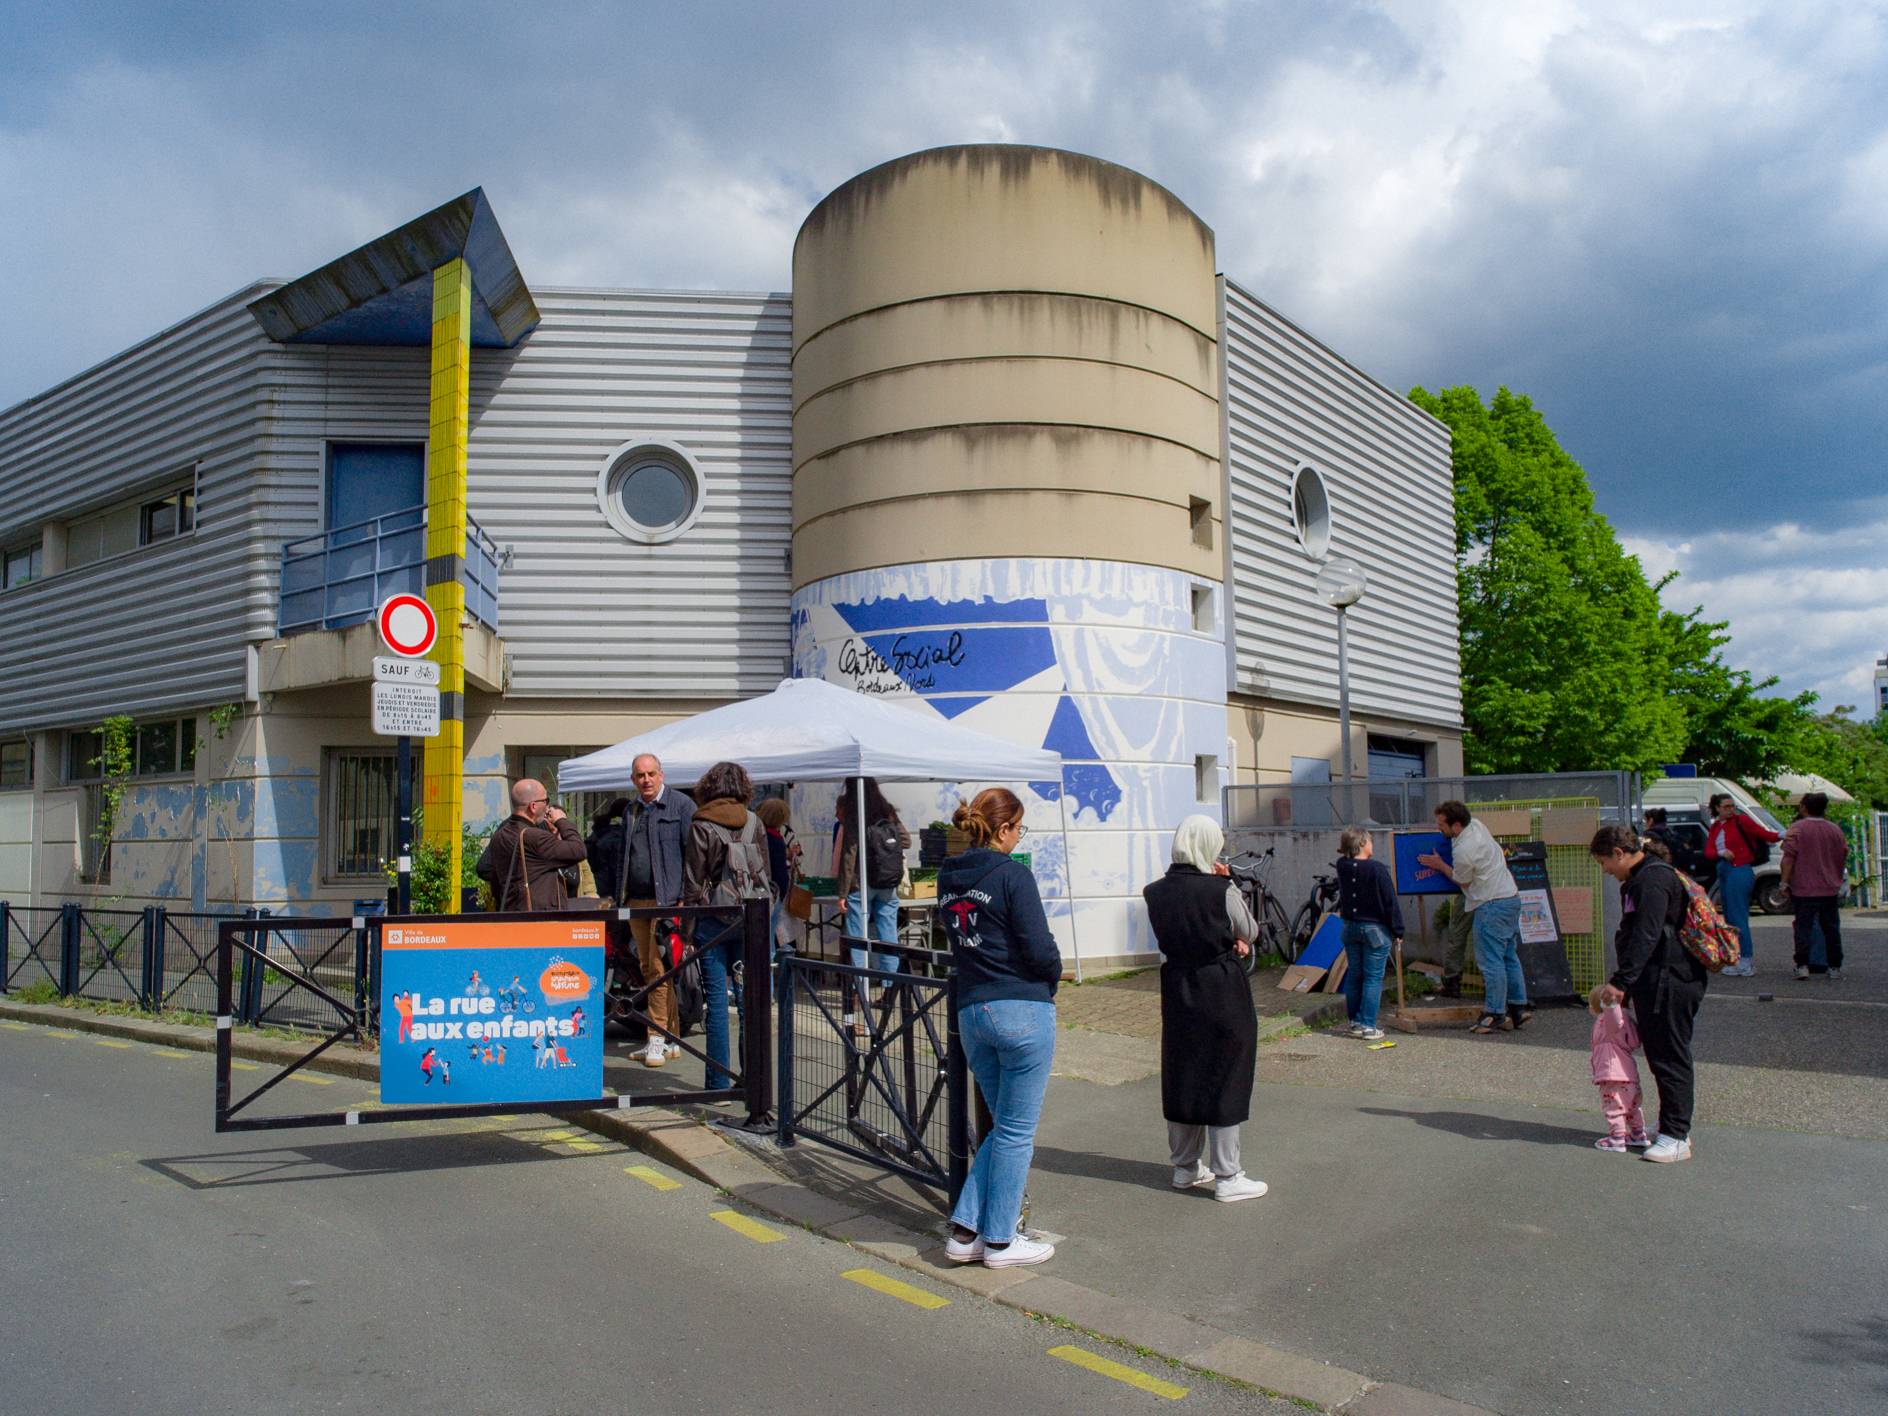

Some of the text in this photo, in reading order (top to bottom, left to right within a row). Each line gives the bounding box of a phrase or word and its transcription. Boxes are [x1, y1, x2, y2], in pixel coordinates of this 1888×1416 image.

[839, 631, 965, 680] Centre Social
[381, 664, 410, 675] SAUF
[952, 912, 978, 928] J V
[404, 936, 447, 944] BORDEAUX
[412, 993, 495, 1015] La rue
[410, 1015, 574, 1040] aux enfants
